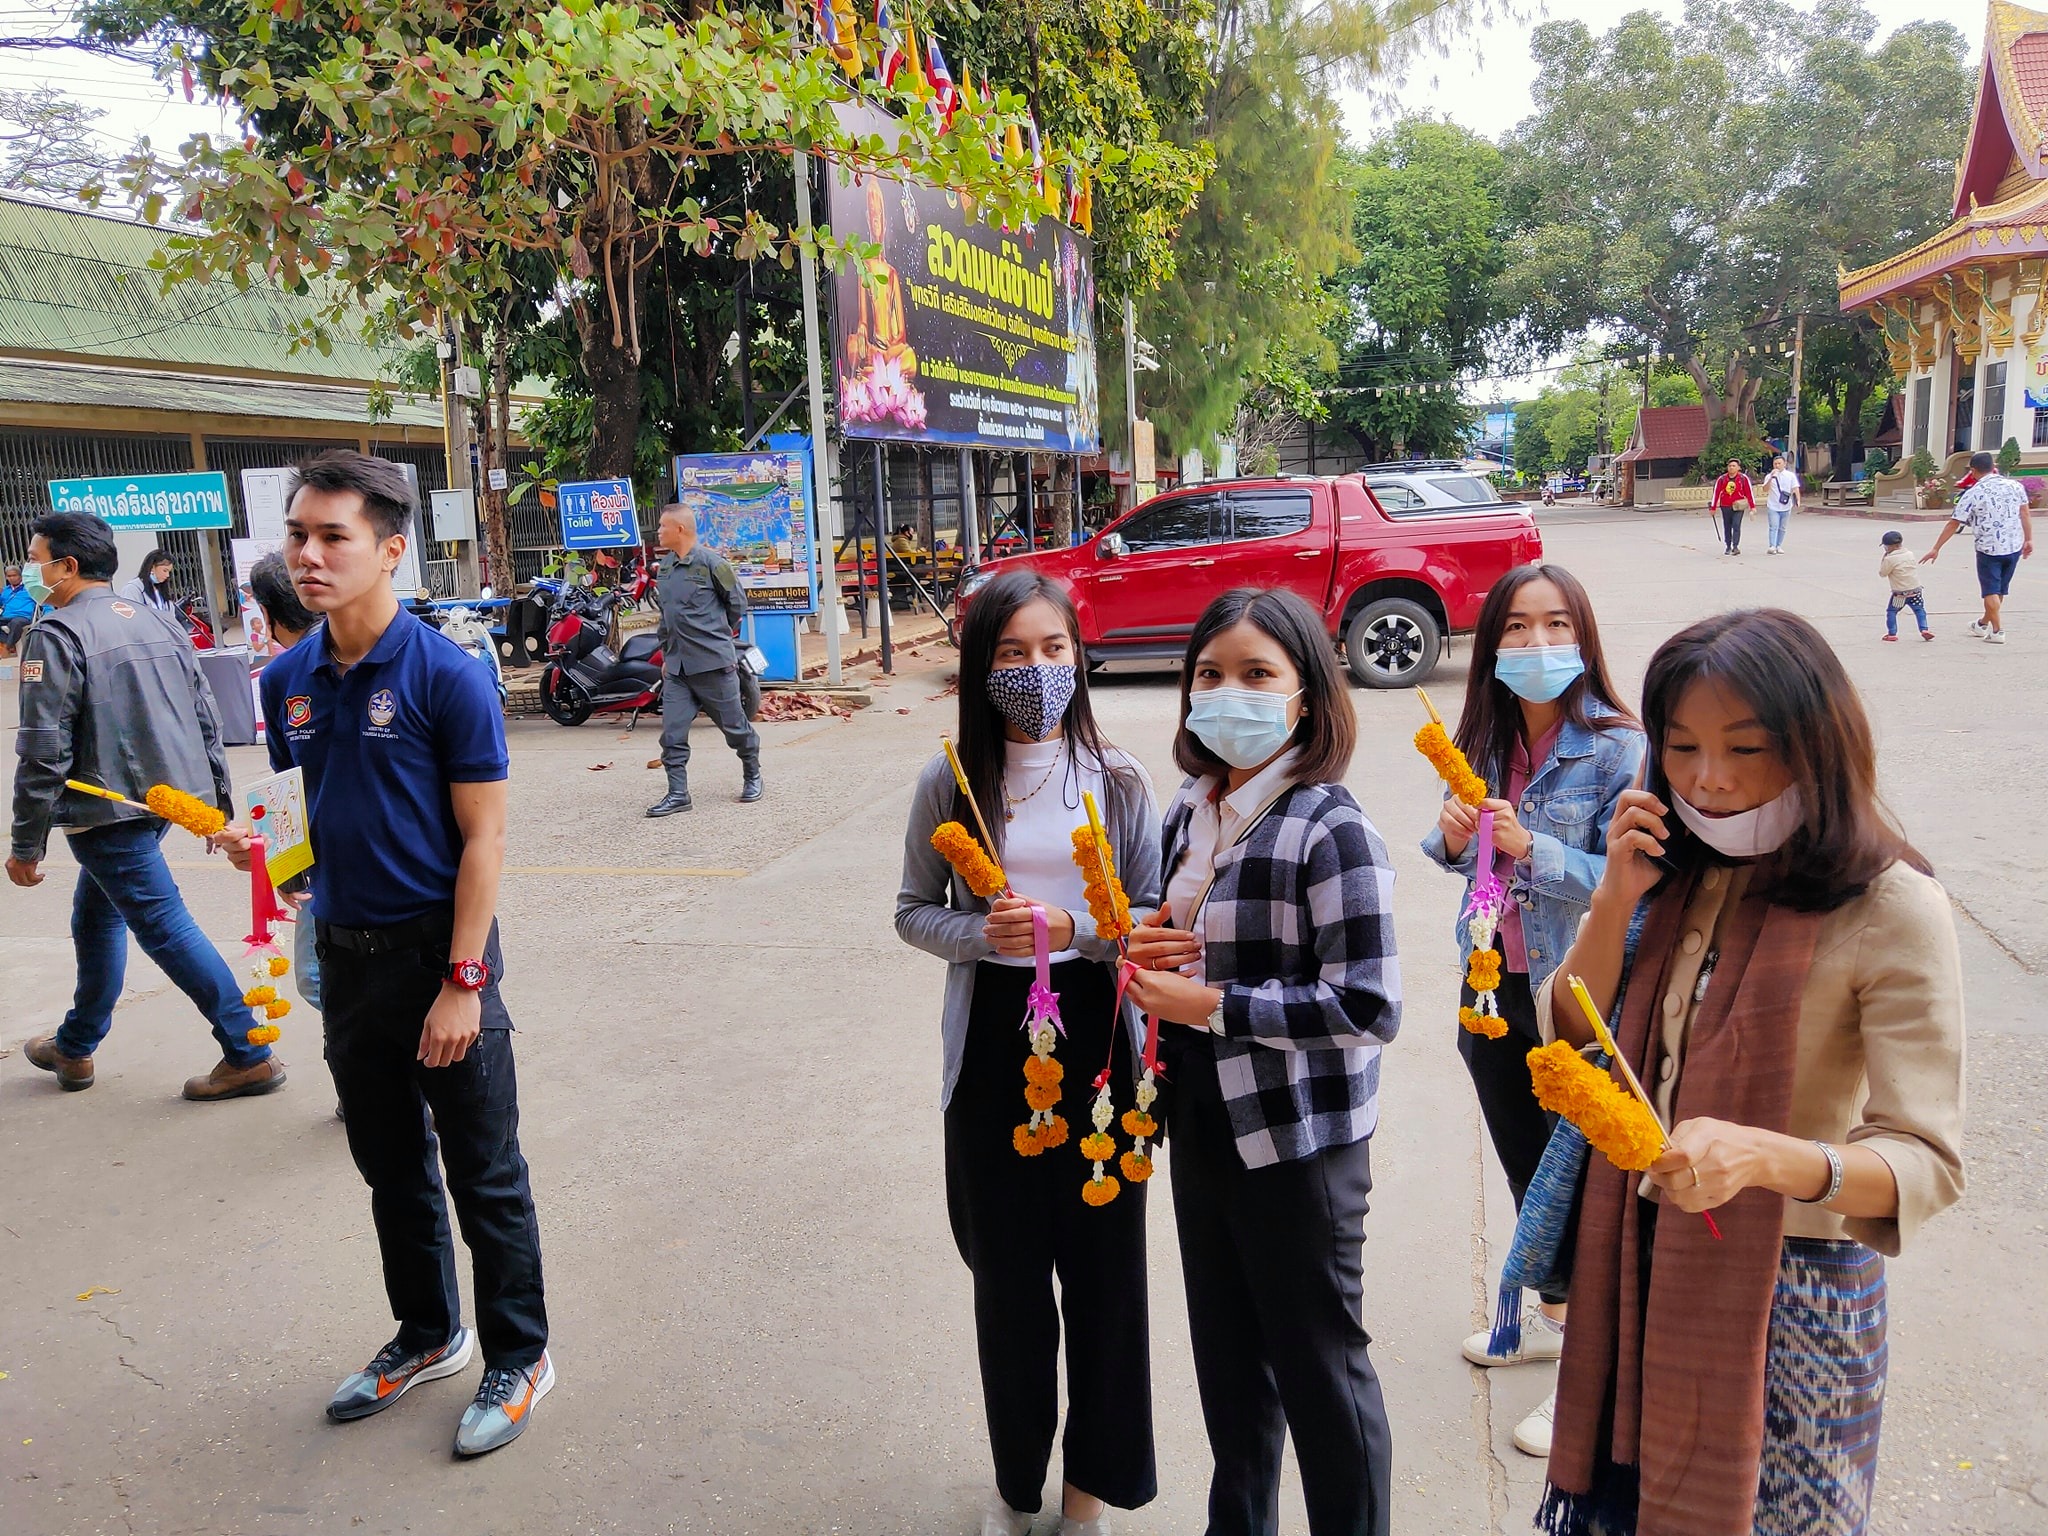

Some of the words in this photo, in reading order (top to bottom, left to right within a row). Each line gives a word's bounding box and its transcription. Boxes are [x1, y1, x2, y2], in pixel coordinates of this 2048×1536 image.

[926, 223, 1054, 320] สวดมนต์ข้ามปี
[57, 483, 224, 526] วัดส่งเสริมสุขภาพ
[590, 483, 630, 512] ห้องน้ำ
[566, 516, 593, 528] Toilet
[601, 511, 624, 532] สุขา
[747, 588, 784, 598] Asawann
[785, 586, 809, 597] Hotel
